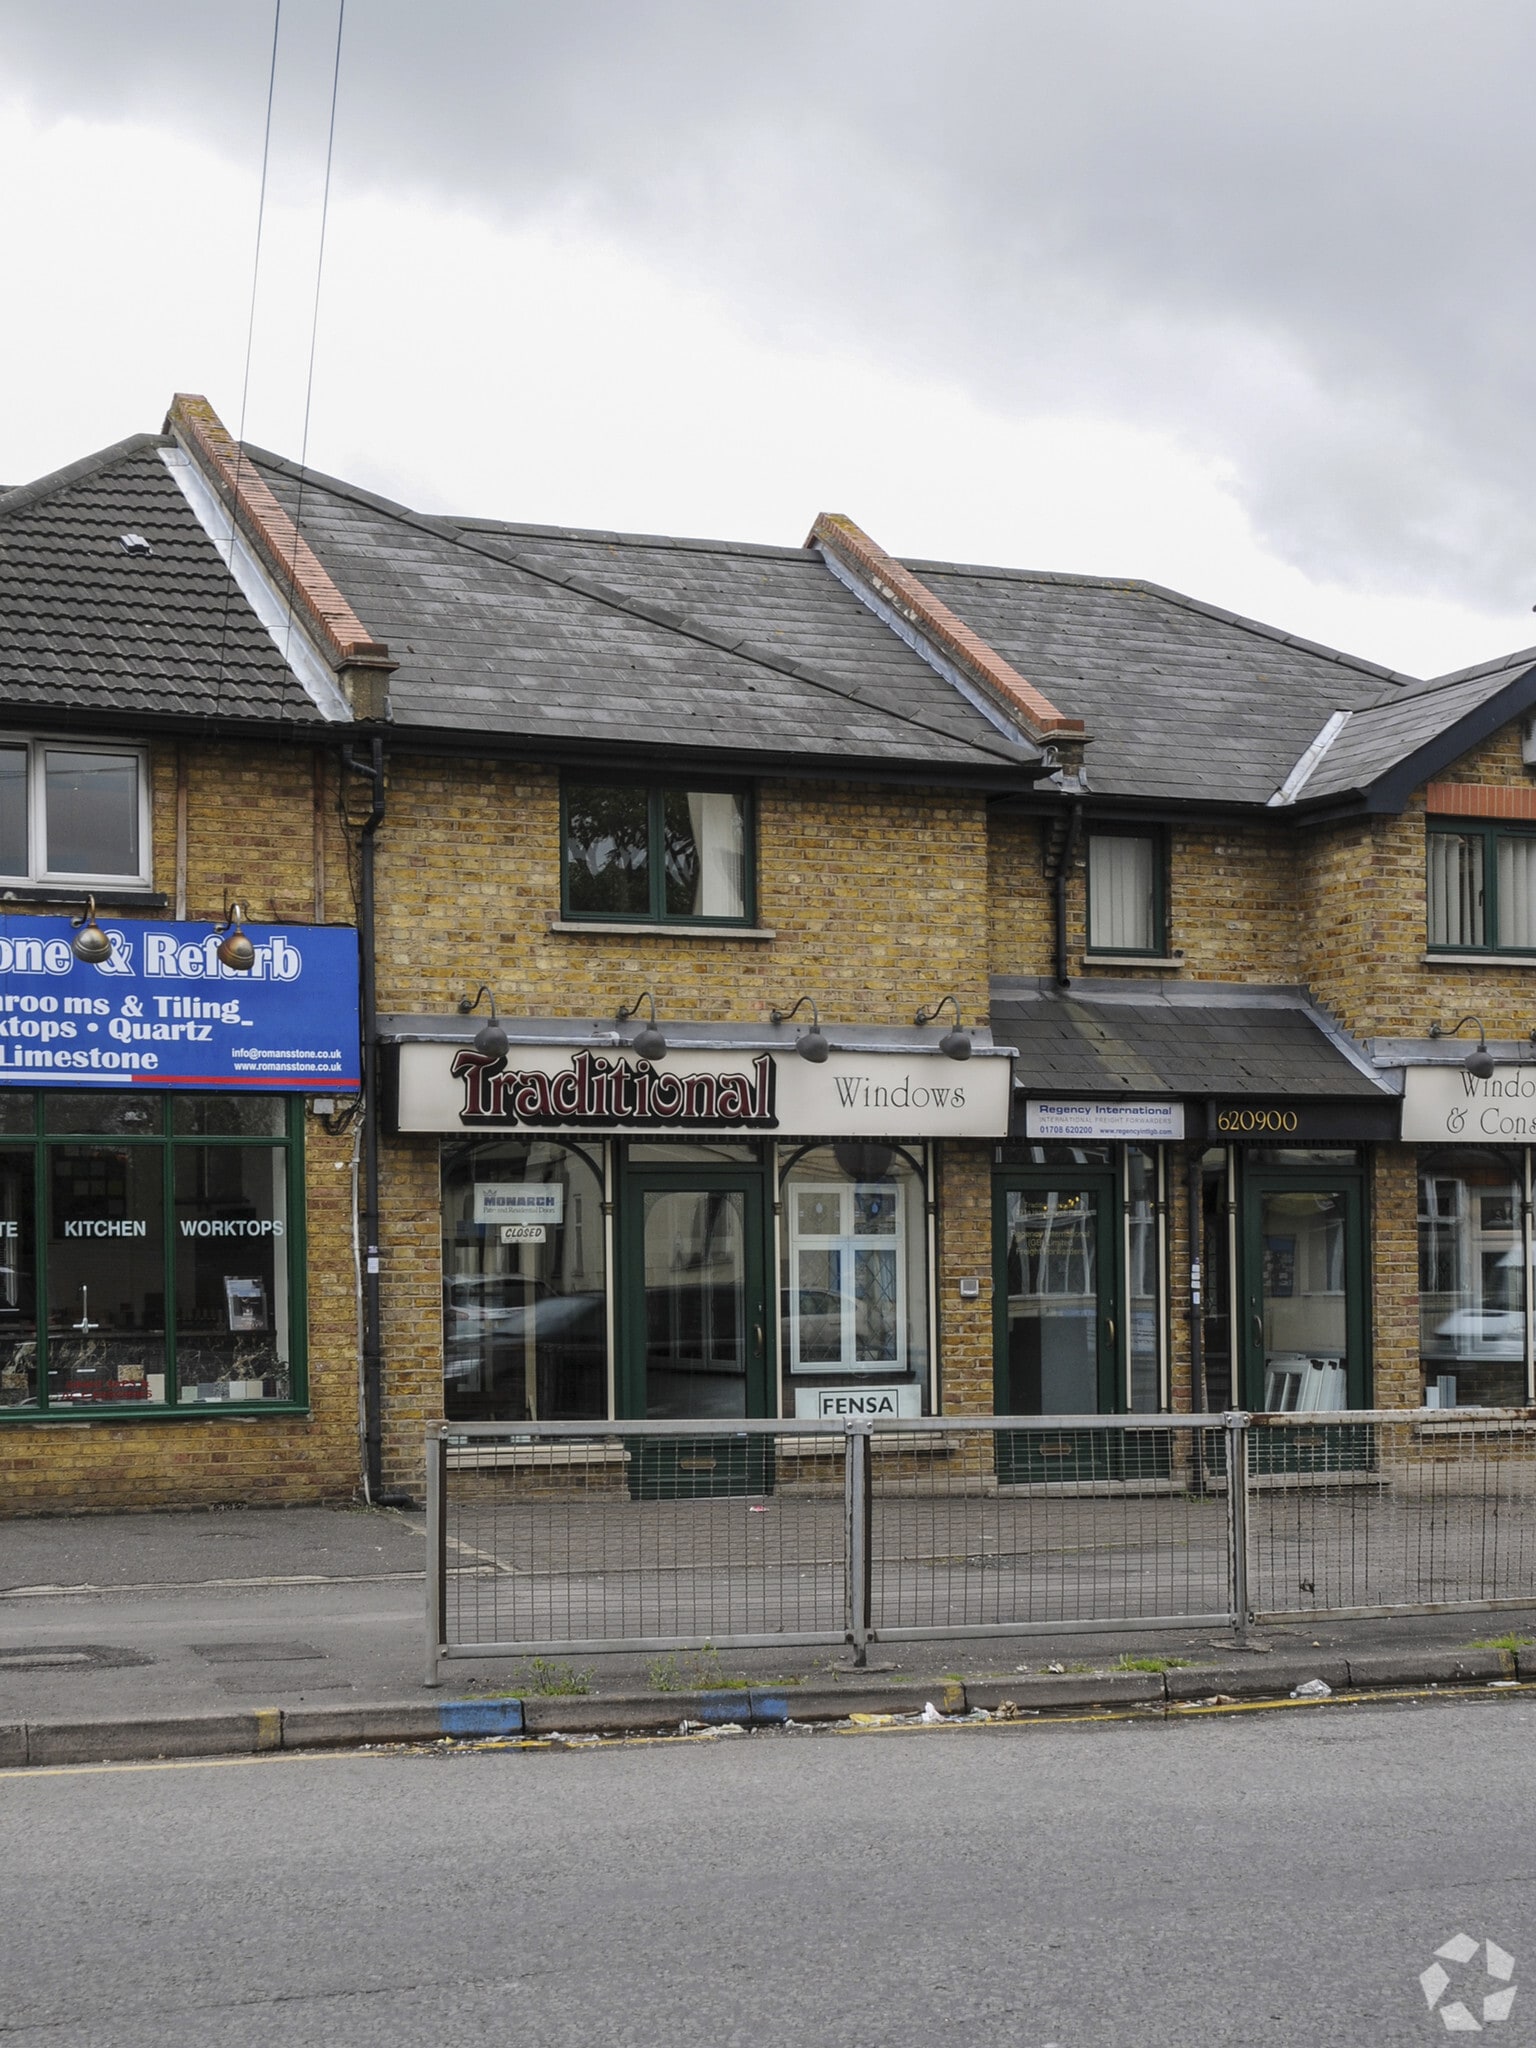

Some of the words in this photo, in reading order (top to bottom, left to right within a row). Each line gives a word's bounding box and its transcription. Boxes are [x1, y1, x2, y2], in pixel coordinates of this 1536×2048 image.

[121, 995, 143, 1017] &
[109, 1018, 213, 1044] Quartz
[232, 1048, 342, 1060] info@romansstone.co.uk
[234, 1062, 342, 1072] www.romansstone.co.uk
[451, 1049, 779, 1128] Traditional
[833, 1075, 966, 1108] Windows
[1039, 1105, 1091, 1115] Regency
[1095, 1105, 1172, 1115] International
[1218, 1110, 1297, 1132] 620900
[1446, 1107, 1468, 1134] &
[1039, 1125, 1063, 1134] 01708
[1065, 1125, 1093, 1134] 620200
[484, 1196, 555, 1206] MONARCH
[65, 1221, 146, 1236] KITCHEN
[181, 1221, 284, 1236] WORKTOPS
[505, 1228, 542, 1238] CLOSED
[823, 1396, 894, 1416] FENSA
